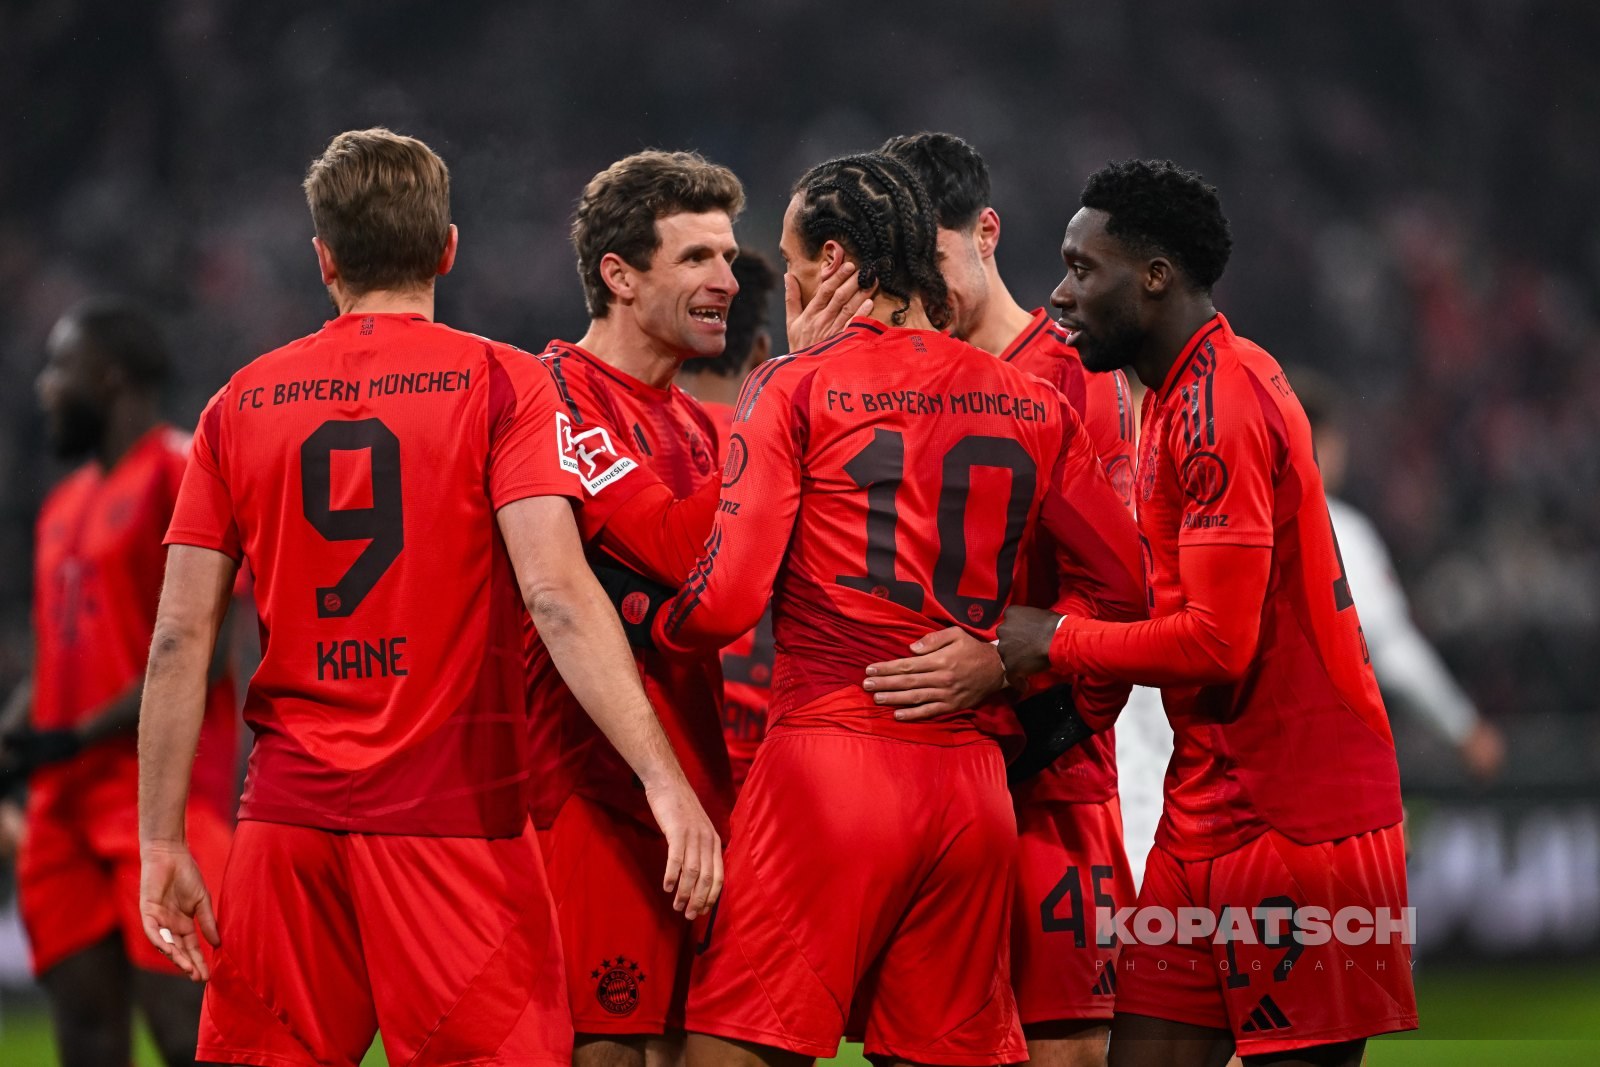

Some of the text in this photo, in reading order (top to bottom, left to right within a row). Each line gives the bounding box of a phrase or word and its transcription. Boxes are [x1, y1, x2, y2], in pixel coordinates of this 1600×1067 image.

[239, 368, 471, 411] FC BAYERN MÜNCHEN
[827, 389, 1046, 423] FC BAYERN MÜNCHEN
[591, 460, 631, 489] BUNDESLIGA
[301, 417, 403, 619] 9
[835, 427, 1038, 631] 10
[316, 636, 409, 681] KANE
[1040, 865, 1117, 949] 45
[1219, 894, 1305, 990] 19
